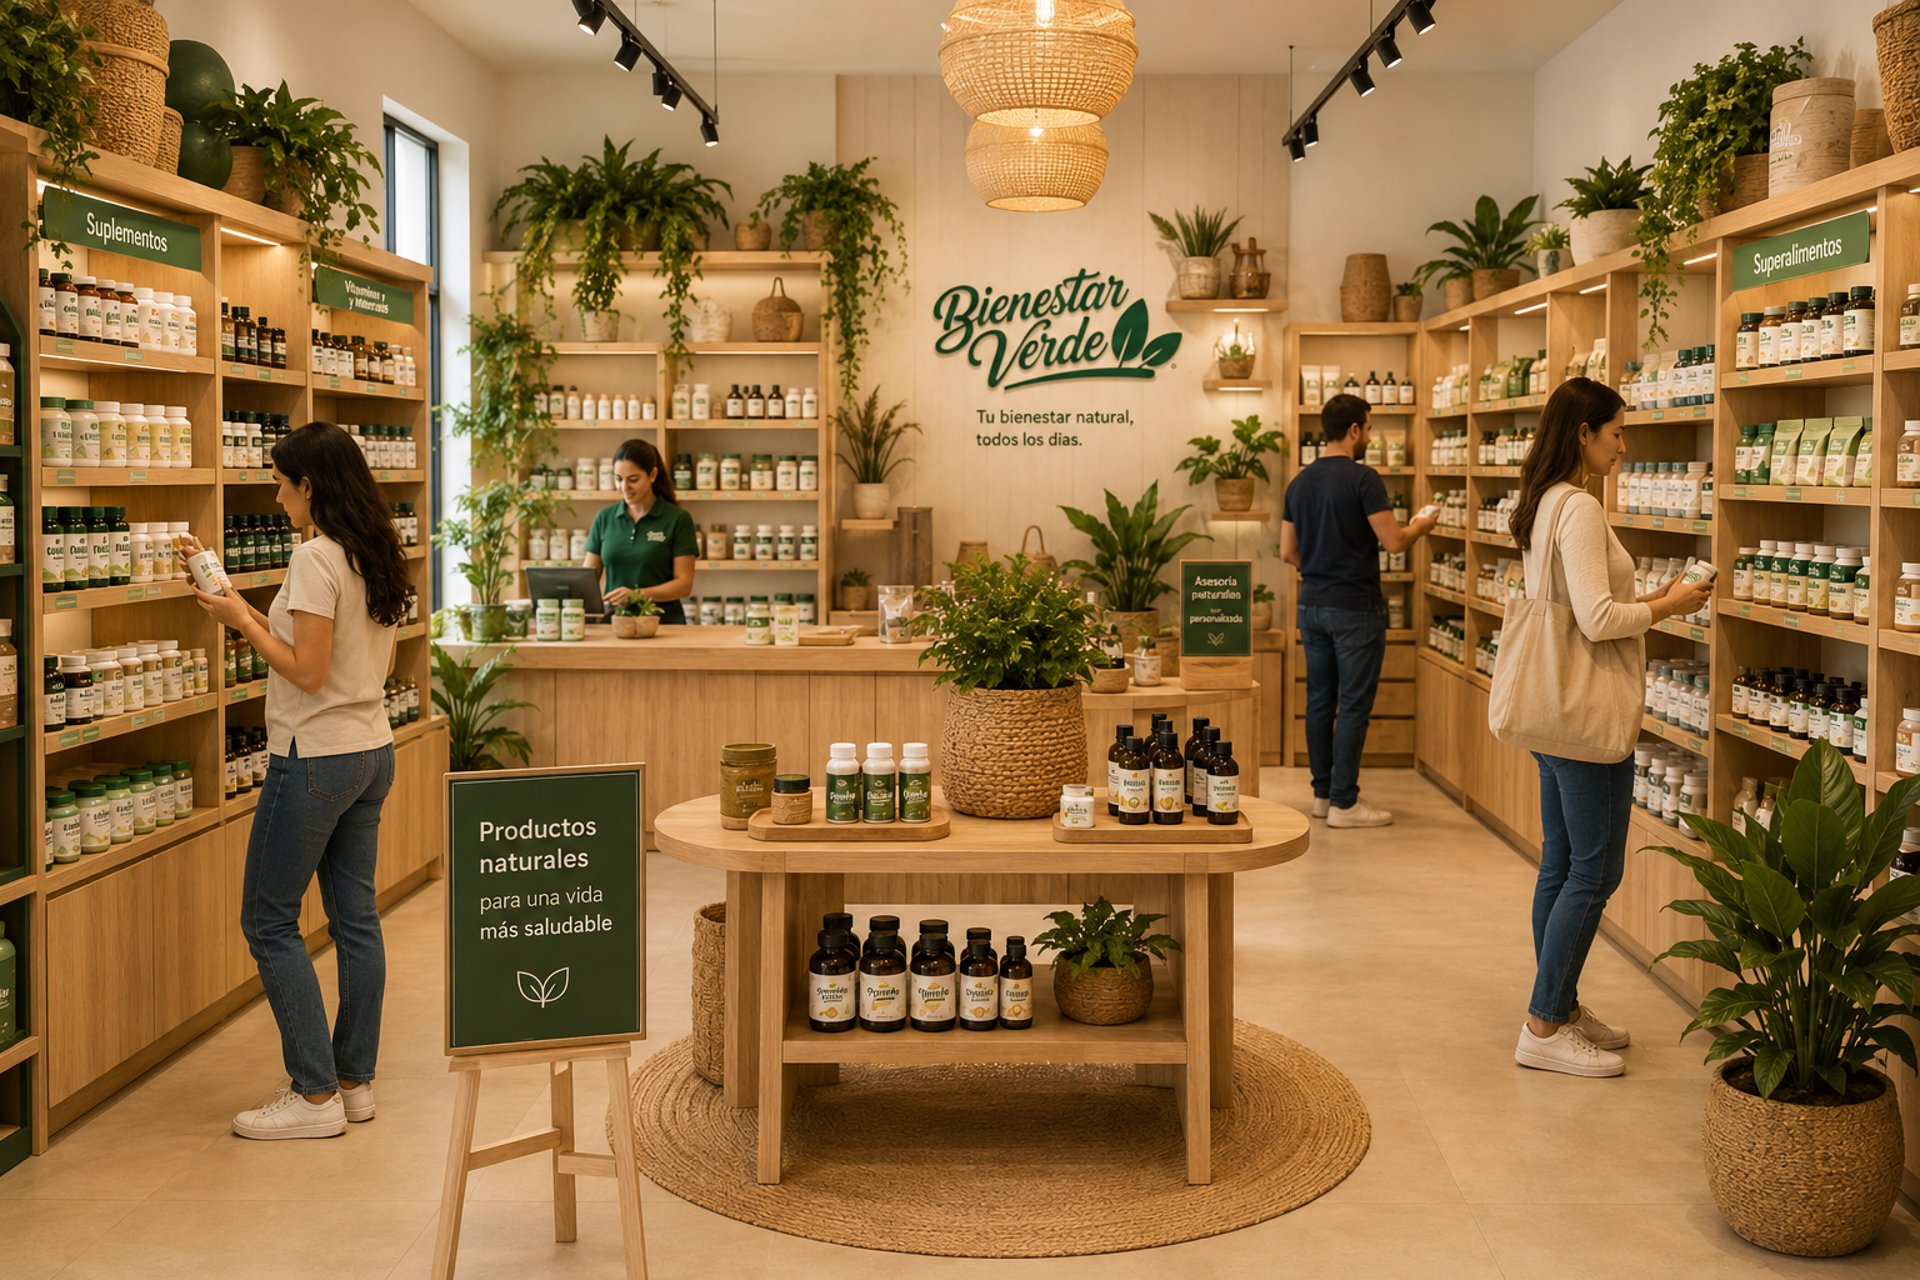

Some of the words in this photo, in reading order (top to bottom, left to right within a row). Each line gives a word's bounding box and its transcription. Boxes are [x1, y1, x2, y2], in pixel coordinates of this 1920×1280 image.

[86, 213, 168, 253] Suplementos
[1753, 237, 1842, 278] Superalimentos
[933, 268, 1129, 354] Bienestar
[968, 317, 1108, 388] Verde
[976, 409, 995, 424] Tu
[1000, 409, 1071, 425] bienestar
[1076, 409, 1134, 426] natural,
[976, 432, 1019, 447] todos
[1023, 432, 1044, 447] los
[480, 818, 597, 842] Productos
[480, 848, 589, 873] naturales
[480, 894, 521, 915] para
[527, 892, 560, 907] una
[565, 885, 603, 905] vida
[480, 921, 519, 940] más
[524, 914, 613, 937] saludable
